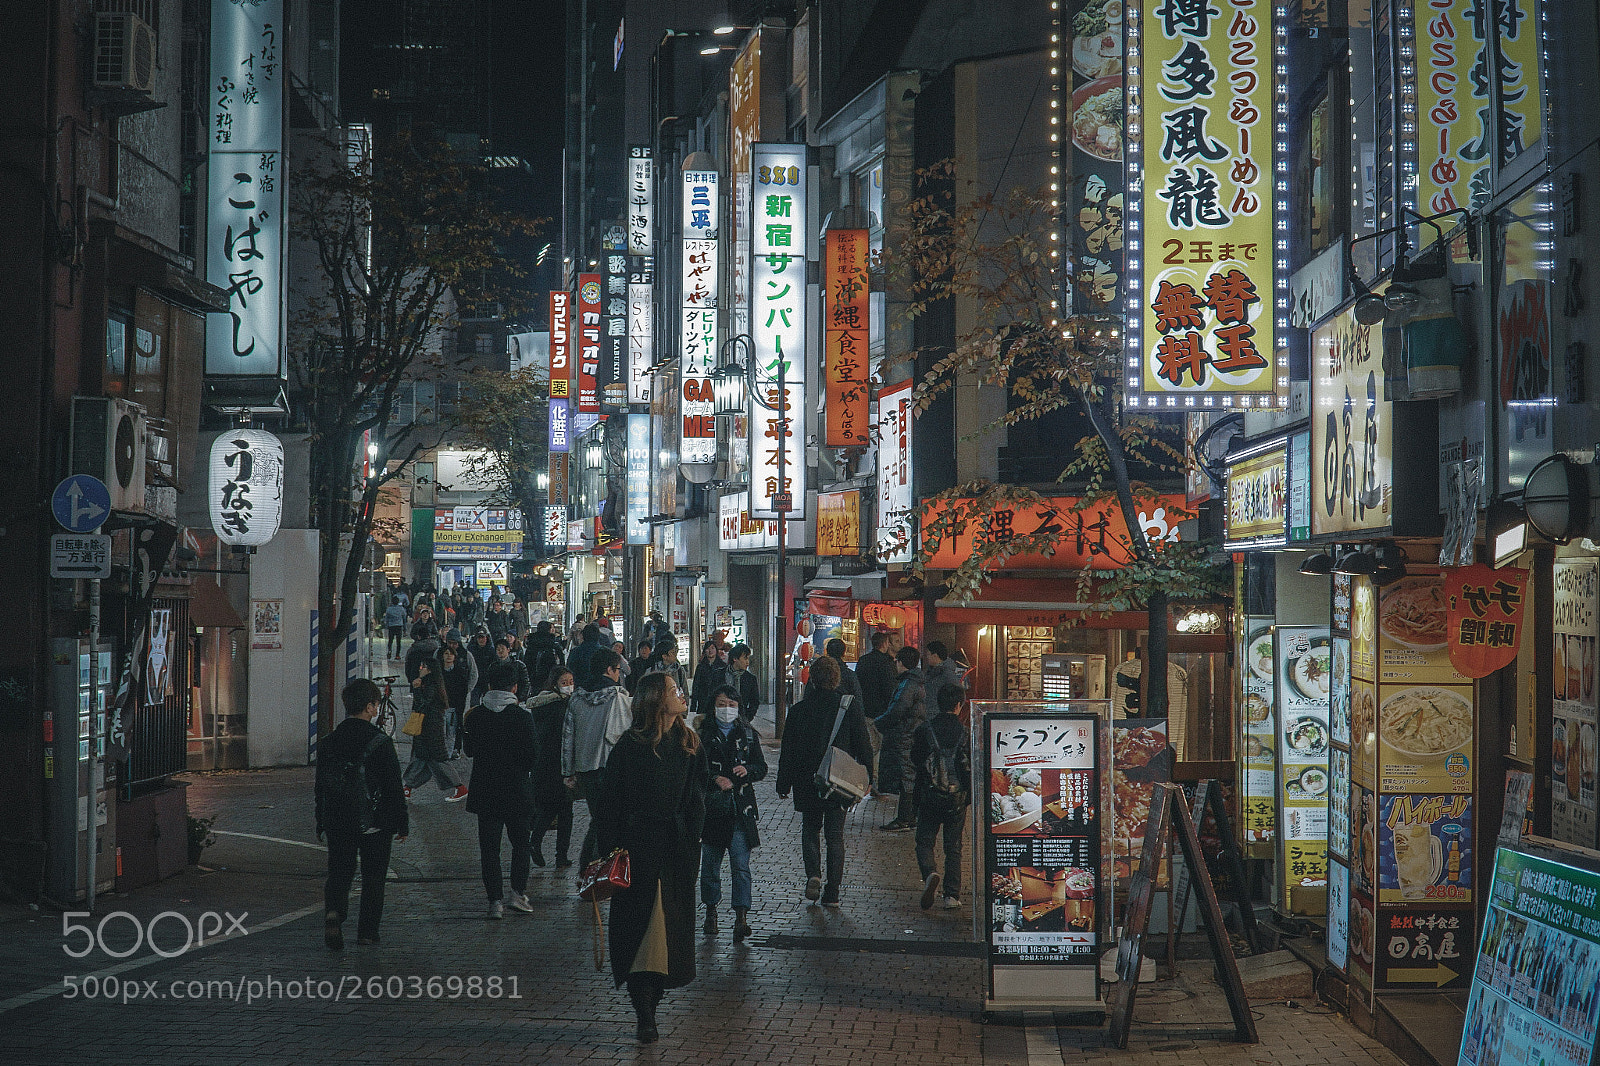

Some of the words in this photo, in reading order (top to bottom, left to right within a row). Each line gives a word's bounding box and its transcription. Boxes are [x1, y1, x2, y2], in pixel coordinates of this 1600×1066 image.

[260, 23, 278, 81] うなぎ
[241, 53, 259, 104] すき焼
[216, 76, 235, 144] ふぐ料理
[631, 147, 651, 157] 3F
[259, 153, 276, 193] 新宿
[685, 173, 716, 183] 日本料理
[758, 165, 800, 186] 389
[690, 186, 711, 229] 三平
[685, 241, 717, 250] レストラン
[837, 233, 847, 273] 伝統料理
[1162, 239, 1258, 264] 2玉まで
[224, 172, 269, 357] こばやし
[631, 273, 650, 283] 2F
[552, 293, 567, 368] サンドラッグ
[701, 311, 715, 367] ビリヤード
[1152, 281, 1209, 386] 無料
[1202, 270, 1266, 373] 替玉
[613, 339, 621, 380] KABUKIYA
[685, 311, 699, 374] ダーツゲーム
[552, 381, 567, 396] 薬
[552, 406, 567, 446] 化粧品
[628, 449, 649, 459] 100
[221, 439, 253, 536] うなぎ
[55, 539, 105, 550] 自転車を除く
[436, 532, 461, 541] Money
[465, 532, 504, 543] EXchange
[55, 551, 105, 563] 一方通行
[996, 724, 1072, 754] ドラゴン
[1386, 795, 1468, 830] ハイボール
[1425, 885, 1466, 899] 280円
[997, 945, 1028, 954] 営業時間
[1388, 932, 1460, 961] 日高屋
